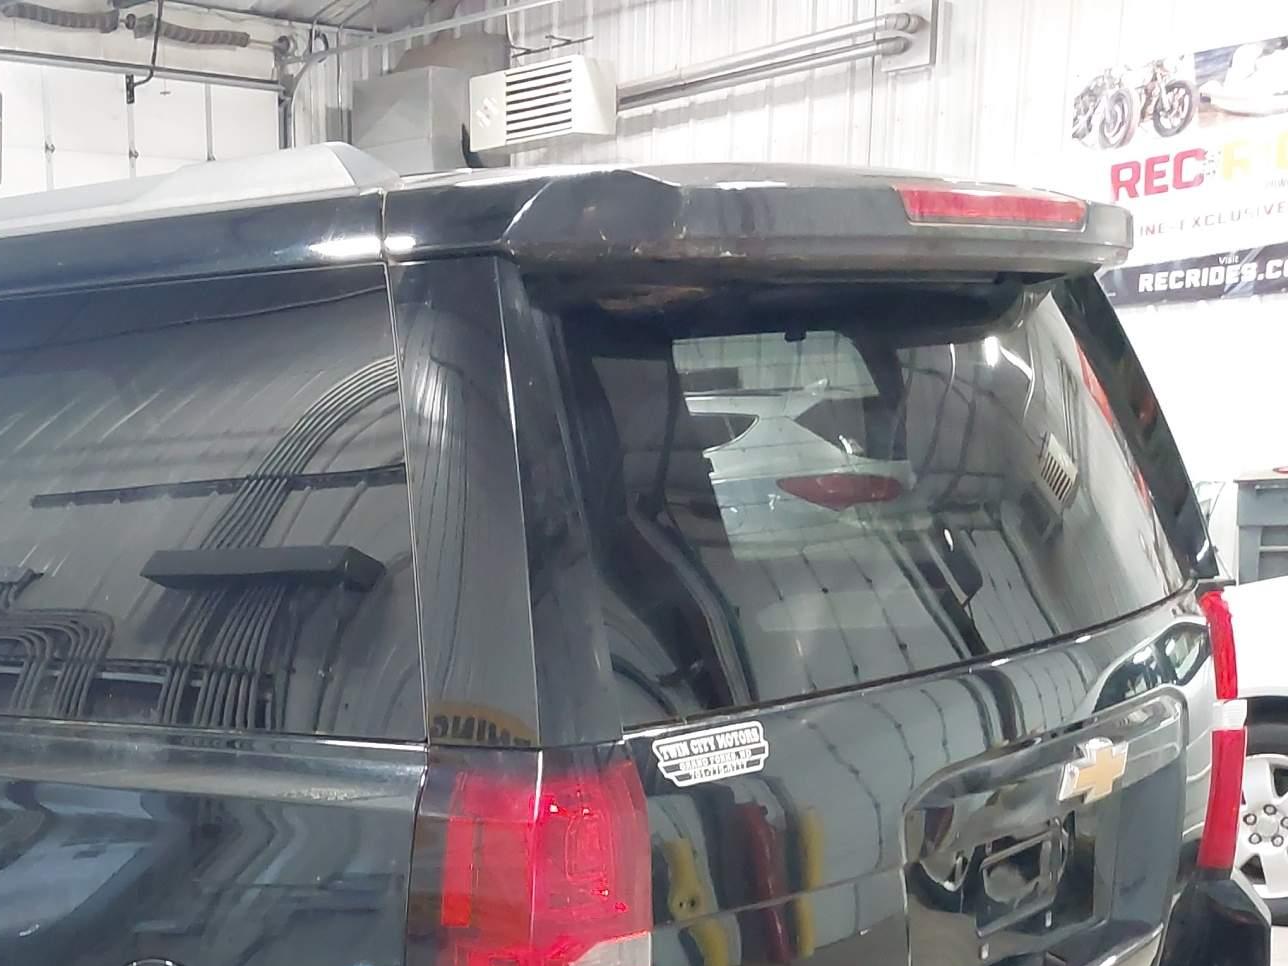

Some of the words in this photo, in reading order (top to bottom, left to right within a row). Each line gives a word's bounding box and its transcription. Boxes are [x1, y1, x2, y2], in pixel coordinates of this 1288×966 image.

[1110, 148, 1208, 202] REC
[1218, 254, 1240, 266] Visit
[658, 740, 691, 760] TWIN
[690, 735, 716, 755] CITY
[715, 727, 760, 749] MOTORS
